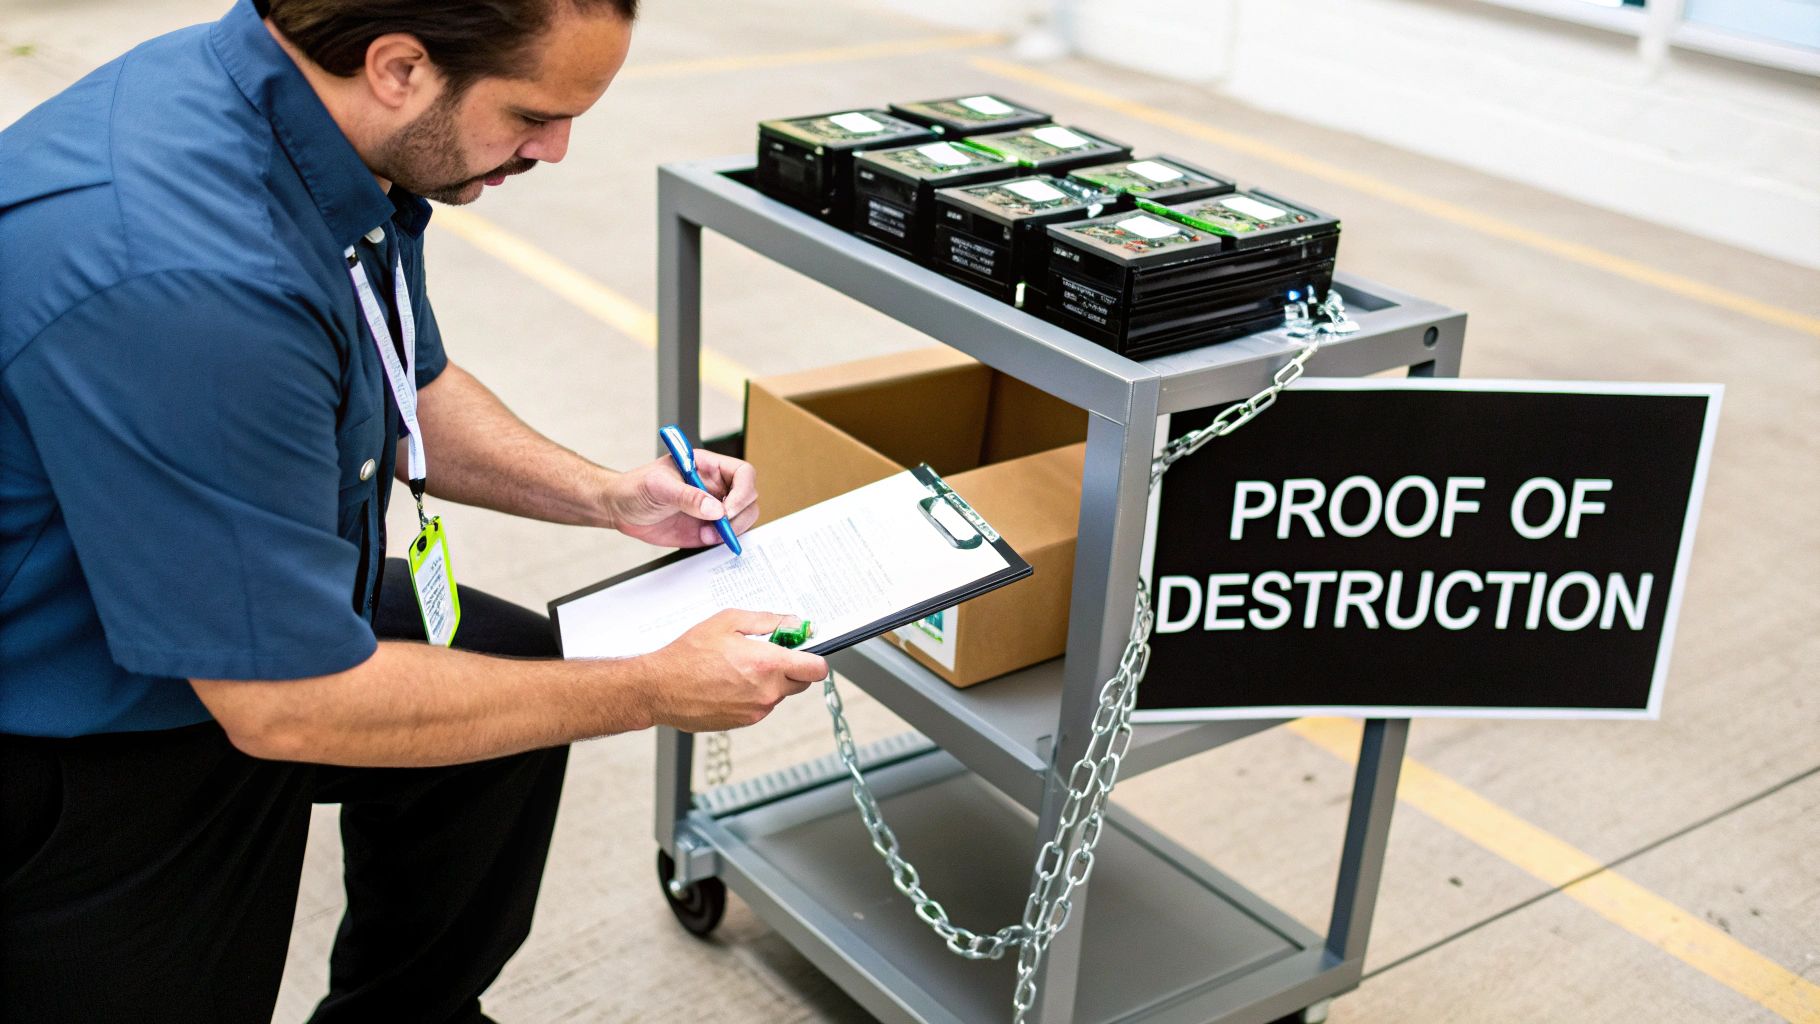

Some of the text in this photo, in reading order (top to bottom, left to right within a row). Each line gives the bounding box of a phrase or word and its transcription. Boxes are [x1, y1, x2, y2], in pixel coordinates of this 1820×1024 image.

[1230, 476, 1613, 540] PROOF OF
[1156, 571, 1654, 634] DESTRUCTION
